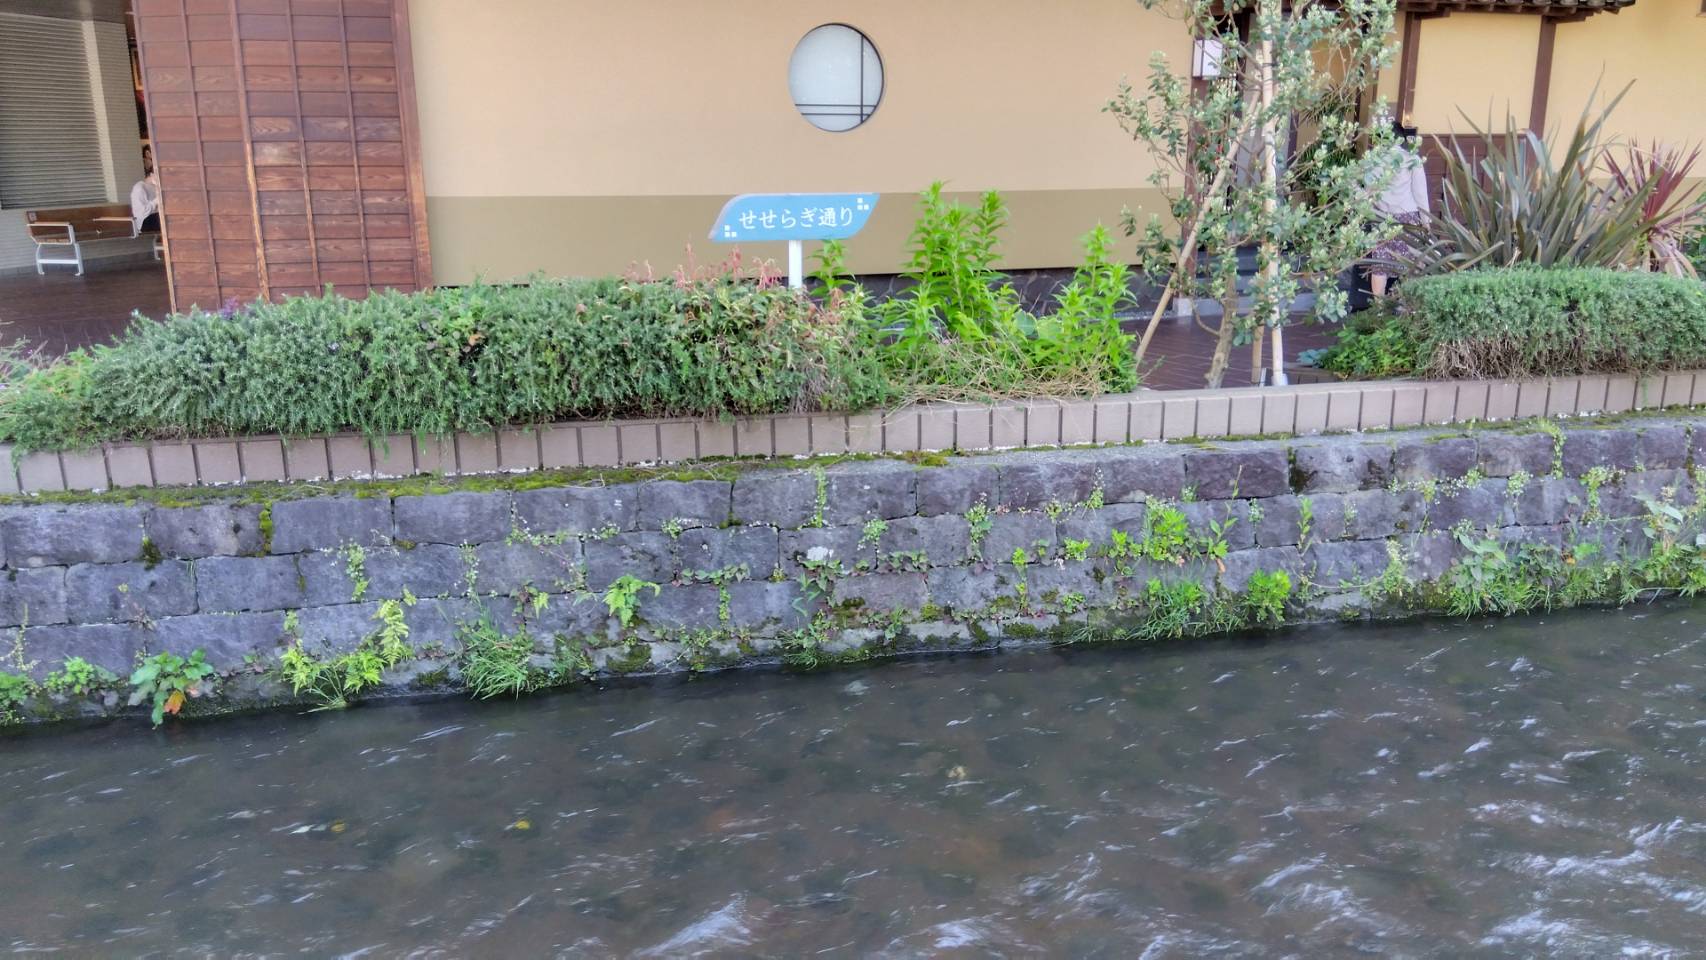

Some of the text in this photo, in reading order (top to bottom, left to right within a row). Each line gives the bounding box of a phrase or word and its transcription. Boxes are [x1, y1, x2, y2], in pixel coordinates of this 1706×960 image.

[739, 206, 853, 229] せせらぎ通り
